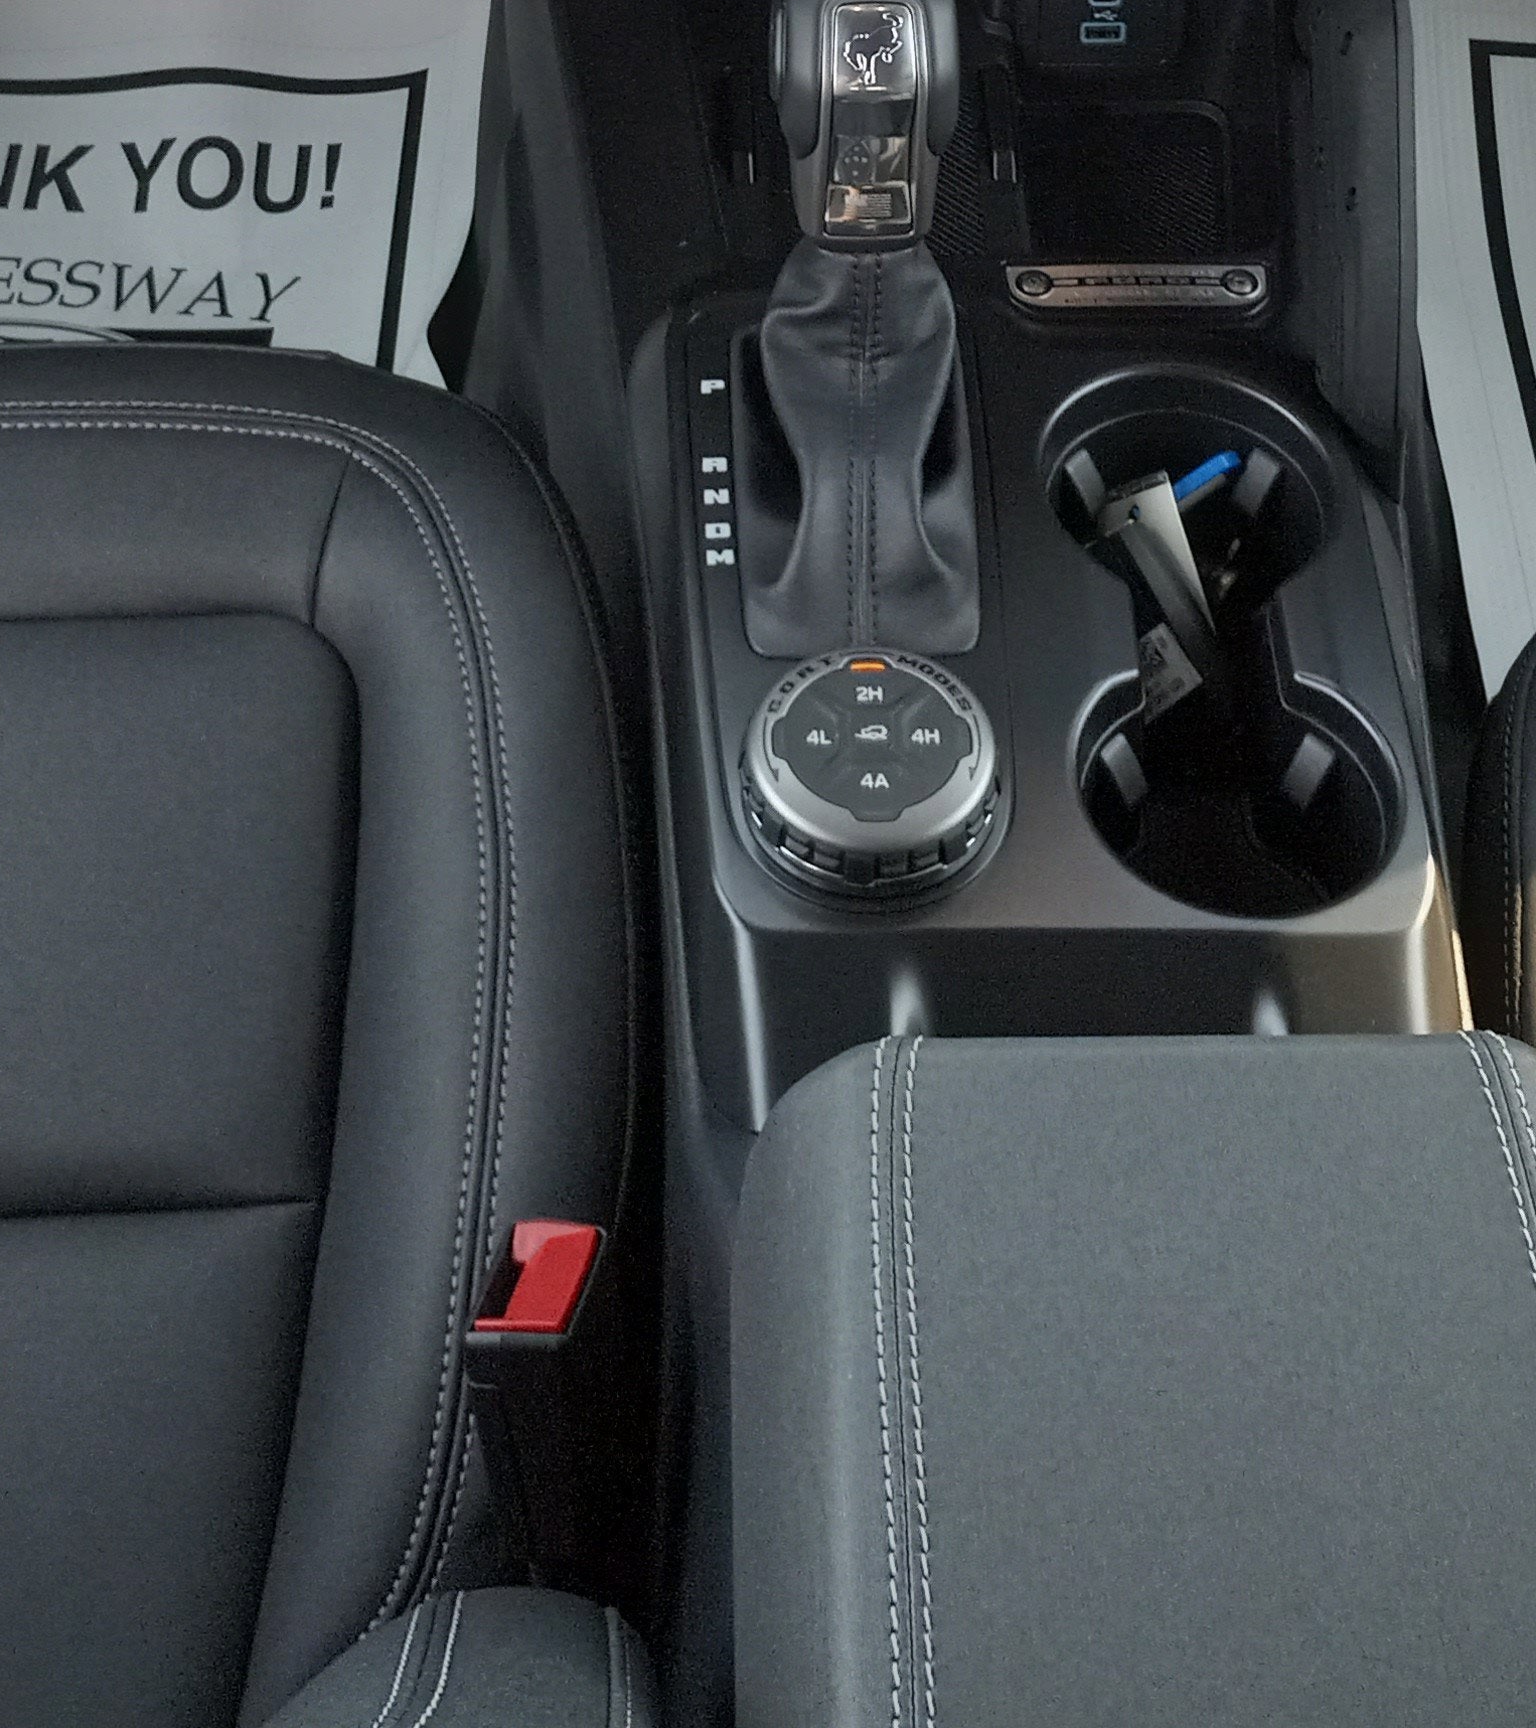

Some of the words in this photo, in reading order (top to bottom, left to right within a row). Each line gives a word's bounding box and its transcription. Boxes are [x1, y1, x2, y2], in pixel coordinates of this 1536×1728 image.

[119, 135, 342, 215] YOU!
[700, 379, 726, 394] P
[703, 488, 730, 505] N
[705, 522, 731, 539] D
[706, 549, 735, 566] M
[855, 685, 884, 703] 2H
[806, 729, 833, 746] 4L
[911, 728, 941, 746] 4H
[860, 773, 890, 790] 4A
